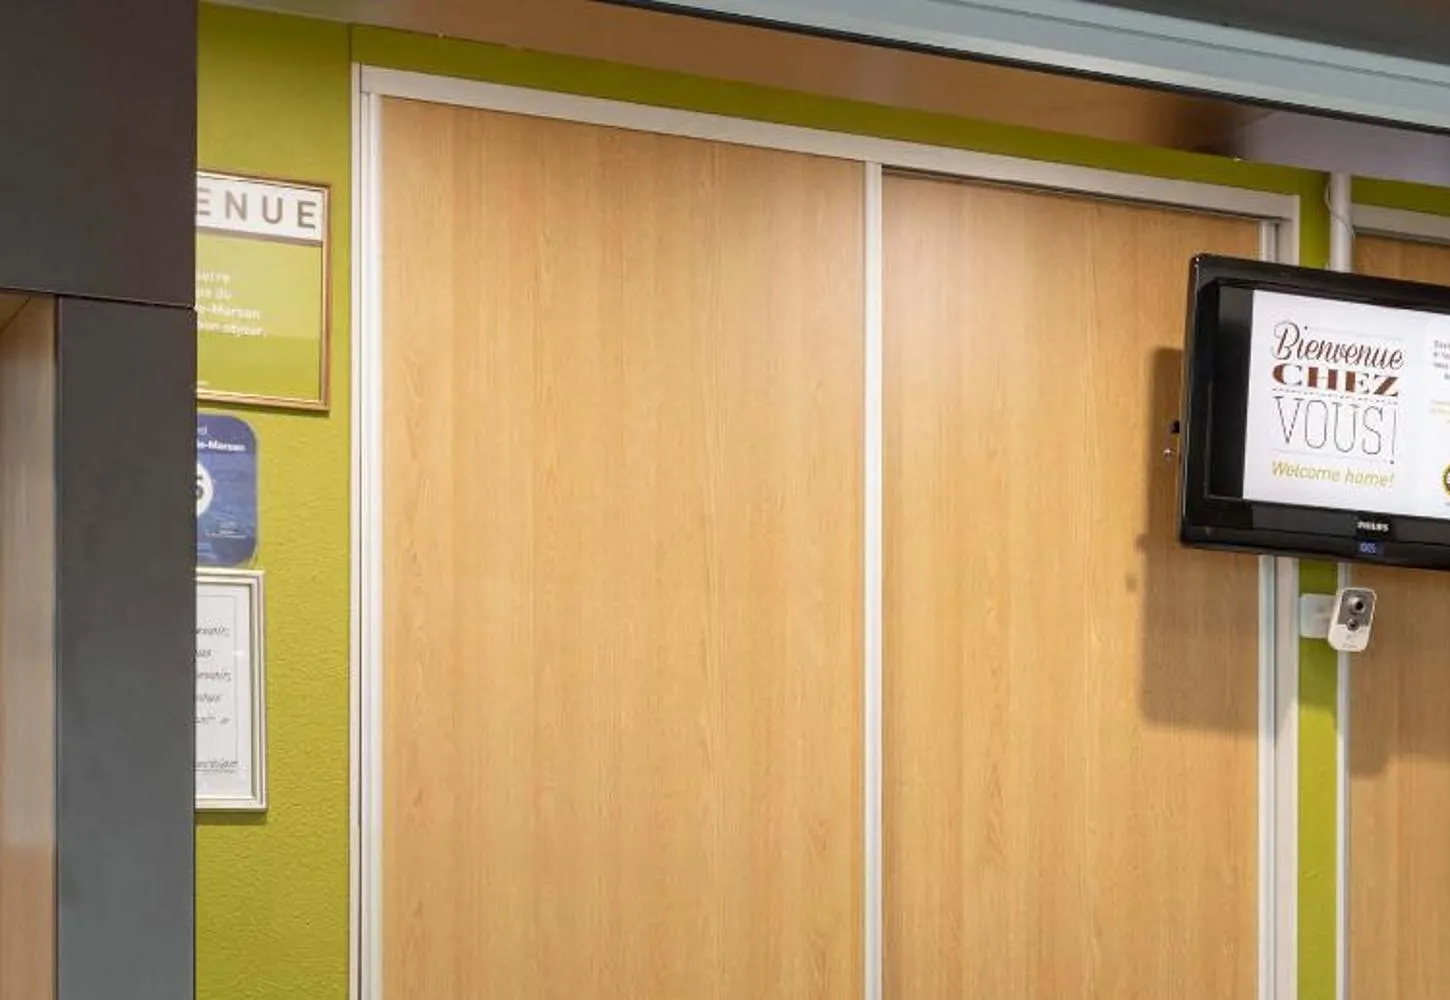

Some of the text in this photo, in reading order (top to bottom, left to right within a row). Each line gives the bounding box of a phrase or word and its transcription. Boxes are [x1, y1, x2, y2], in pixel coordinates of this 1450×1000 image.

[1272, 320, 1404, 370] Bienvenue
[1272, 363, 1400, 397] CHEZ
[1273, 396, 1396, 465] VOUS!
[1272, 460, 1396, 489] Welcome home!
